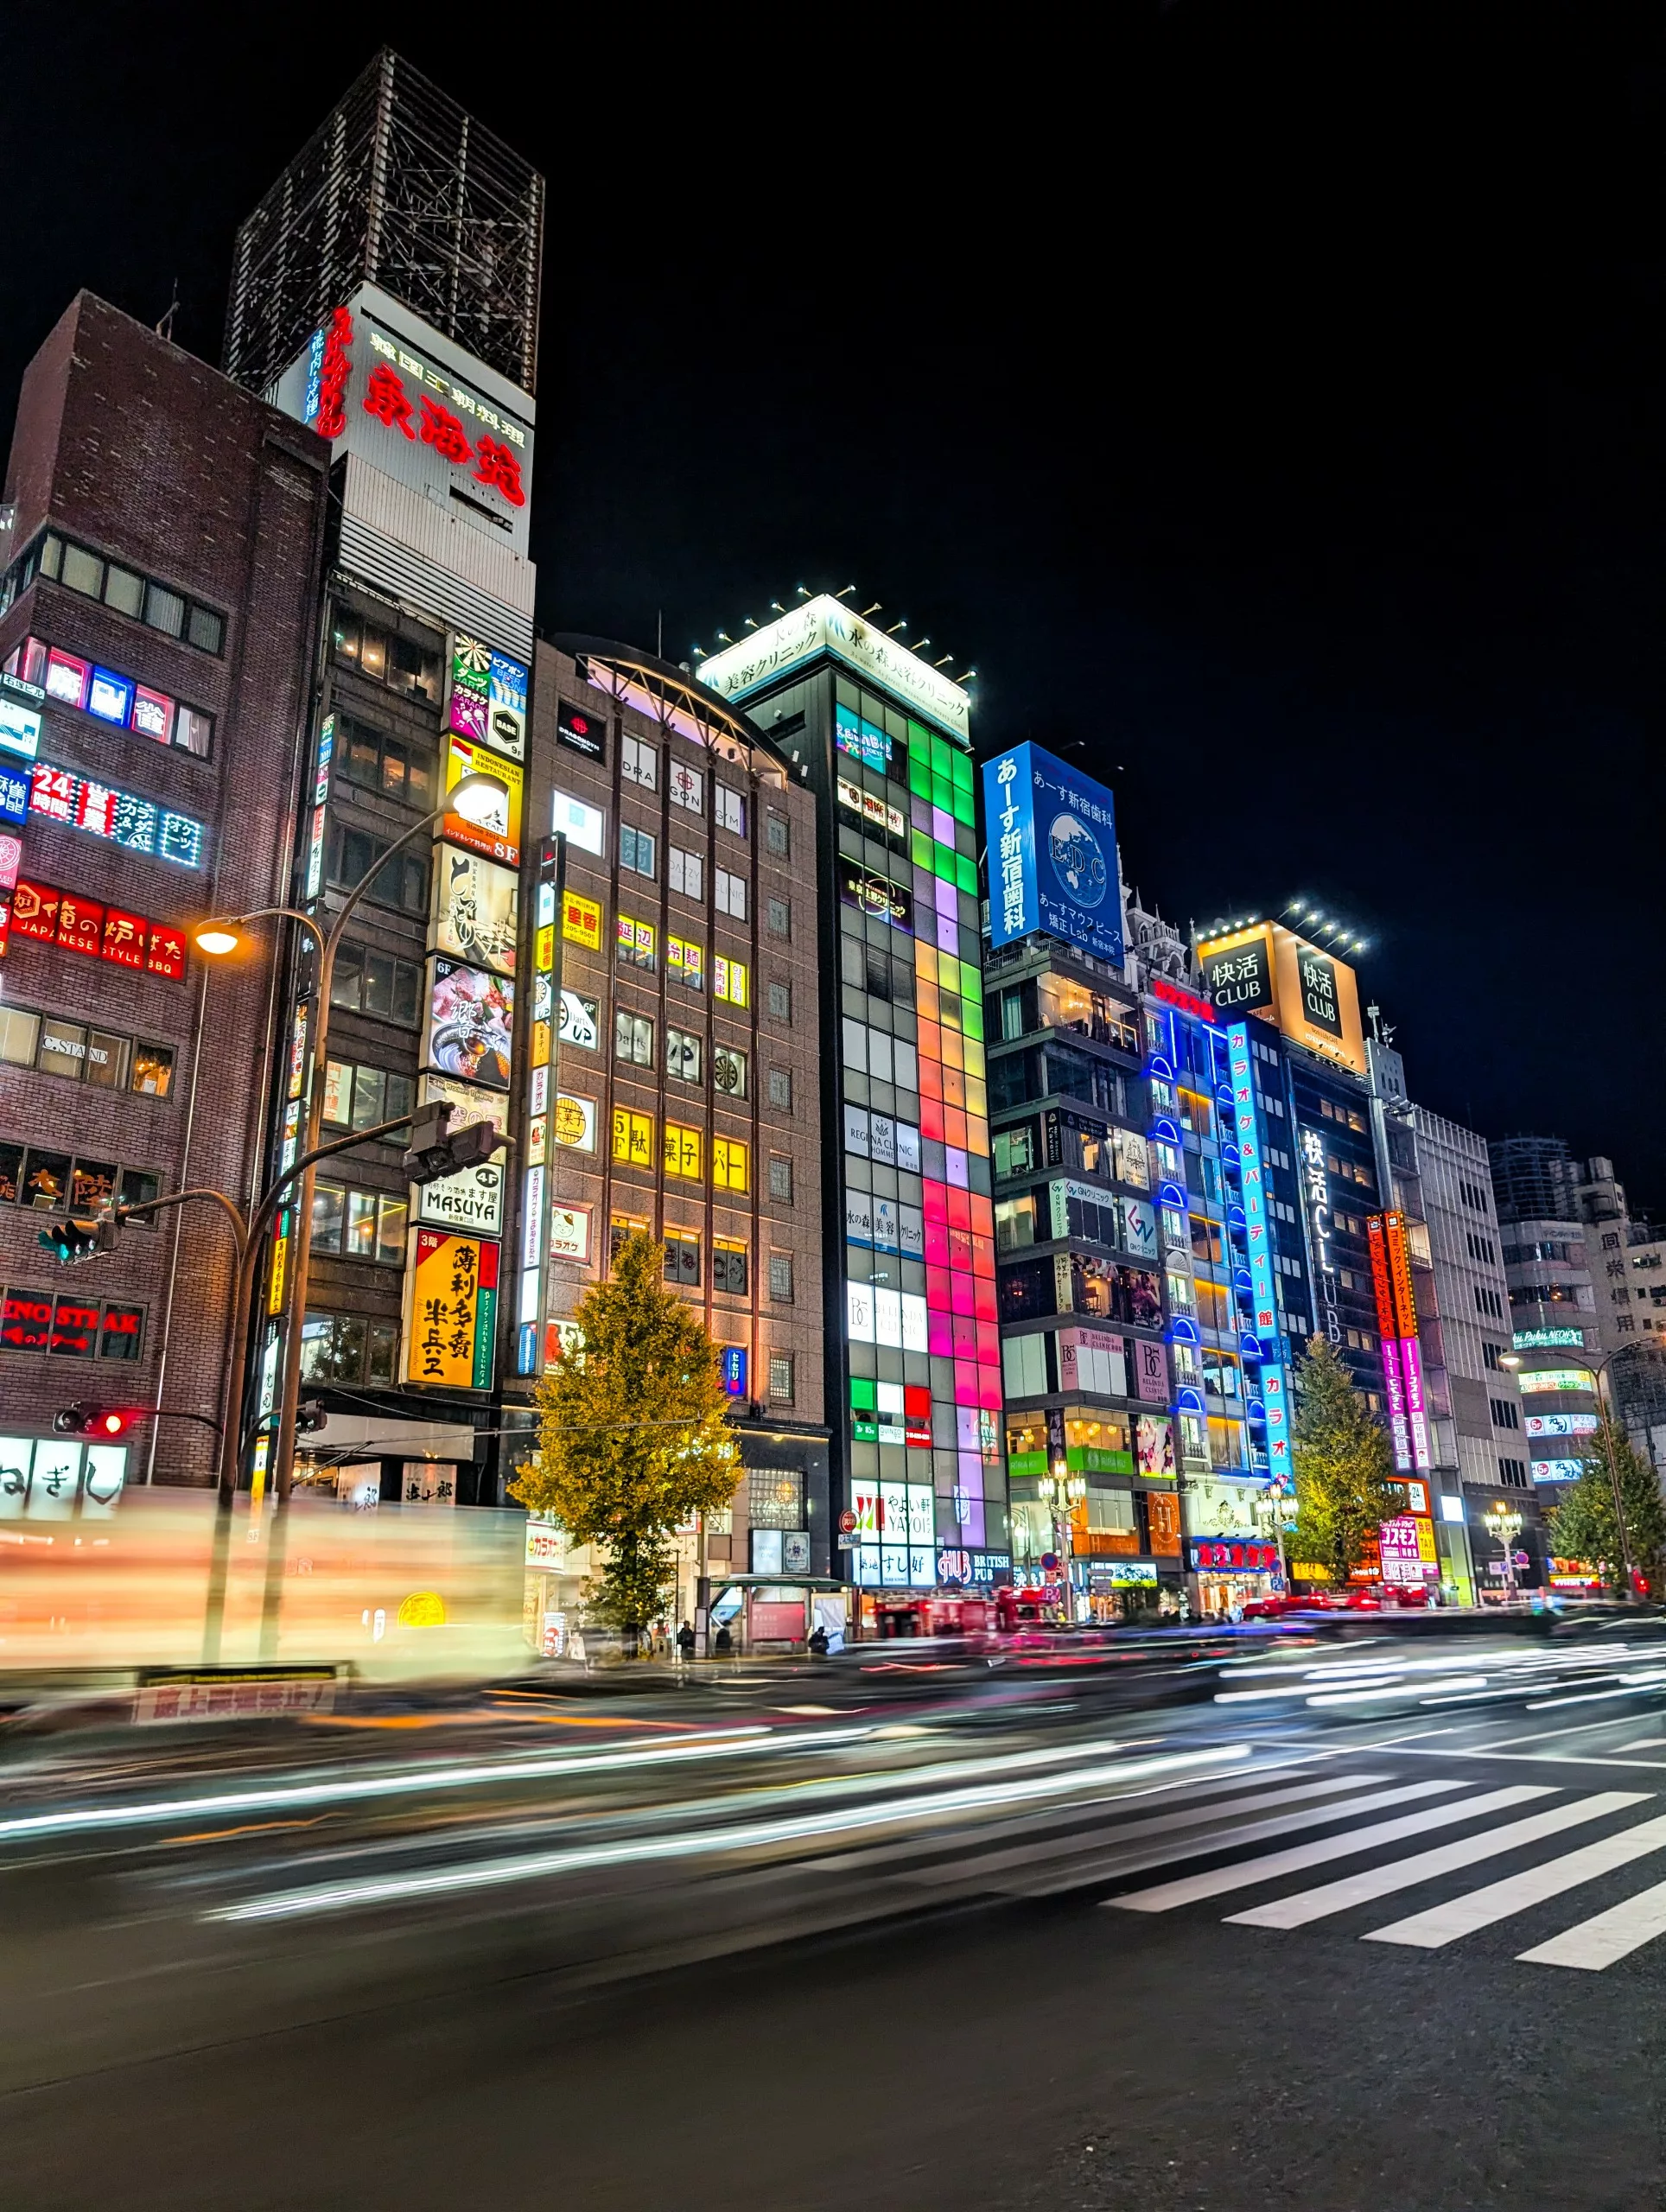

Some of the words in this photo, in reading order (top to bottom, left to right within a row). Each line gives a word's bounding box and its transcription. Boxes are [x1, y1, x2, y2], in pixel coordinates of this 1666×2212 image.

[724, 631, 817, 694] 美容クリニック
[5, 675, 44, 697] 石塚ビル
[455, 684, 488, 705] カラオケ
[454, 693, 490, 715] KARAOKE
[496, 719, 517, 736] BASE
[475, 760, 521, 785] RESTAURANT
[477, 753, 520, 777] INDONESIAN
[35, 769, 69, 798] 24
[32, 791, 68, 817] 時間
[84, 785, 110, 834] 営業
[1033, 770, 1113, 830] あーす新宿歯科
[466, 823, 484, 835] Since
[485, 831, 499, 842] 2012
[493, 842, 518, 862] 8F
[997, 757, 1026, 935] あーす新宿歯科
[563, 905, 598, 933] 里香
[1040, 893, 1122, 944] あーすマウスピース
[21, 921, 95, 950] JAPANESE
[102, 945, 141, 964] STYLE
[1092, 937, 1116, 956] 新宿本院
[437, 962, 452, 975] 6F
[1211, 953, 1258, 987] 快活
[1303, 961, 1332, 1000] 快活
[1215, 981, 1261, 1007] CLUB
[583, 1002, 595, 1013] 6F
[1307, 993, 1336, 1022] CLUB
[570, 1012, 589, 1026] Darts
[850, 1128, 882, 1147] REGINA
[883, 1138, 912, 1156] CLINIC
[871, 1145, 894, 1160] HOMME
[477, 1172, 498, 1185] 4F
[1230, 1033, 1275, 1328] カラオケ&パーティー館
[468, 1187, 498, 1205] ます屋
[1078, 1186, 1110, 1203] GNクリニック
[427, 1192, 495, 1221] MASUYA
[421, 1235, 438, 1249] 3階
[1548, 1330, 1570, 1338] NEON
[888, 1495, 931, 1514] やよい軒
[889, 1516, 925, 1533] YAYOI
[1382, 1528, 1416, 1546] コスモス
[1420, 1538, 1434, 1548] TAX
[974, 1555, 1009, 1568] BRITISH
[1421, 1550, 1434, 1559] FREE
[938, 1550, 972, 1584] HUB
[974, 1568, 994, 1581] PUB
